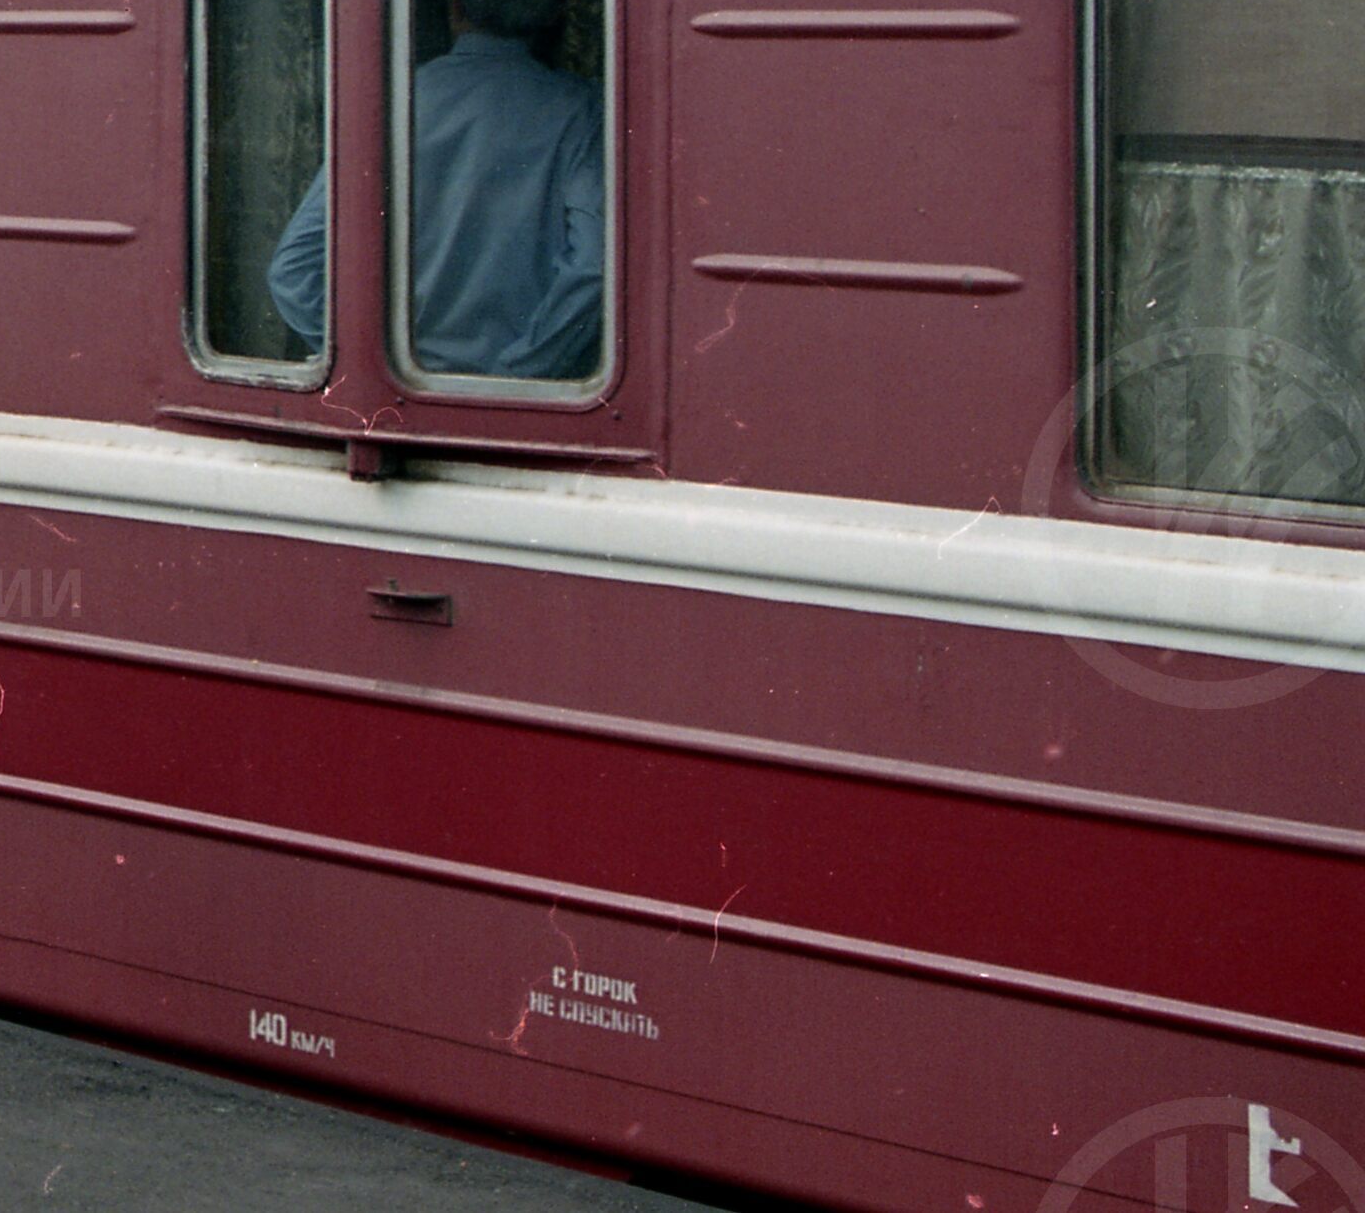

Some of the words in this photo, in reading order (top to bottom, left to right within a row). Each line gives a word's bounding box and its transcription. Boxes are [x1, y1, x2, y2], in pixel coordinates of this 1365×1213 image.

[529, 991, 555, 1017] НЕ
[552, 967, 566, 989] С
[573, 970, 637, 1005] ГОРОК
[250, 1008, 287, 1047] 140
